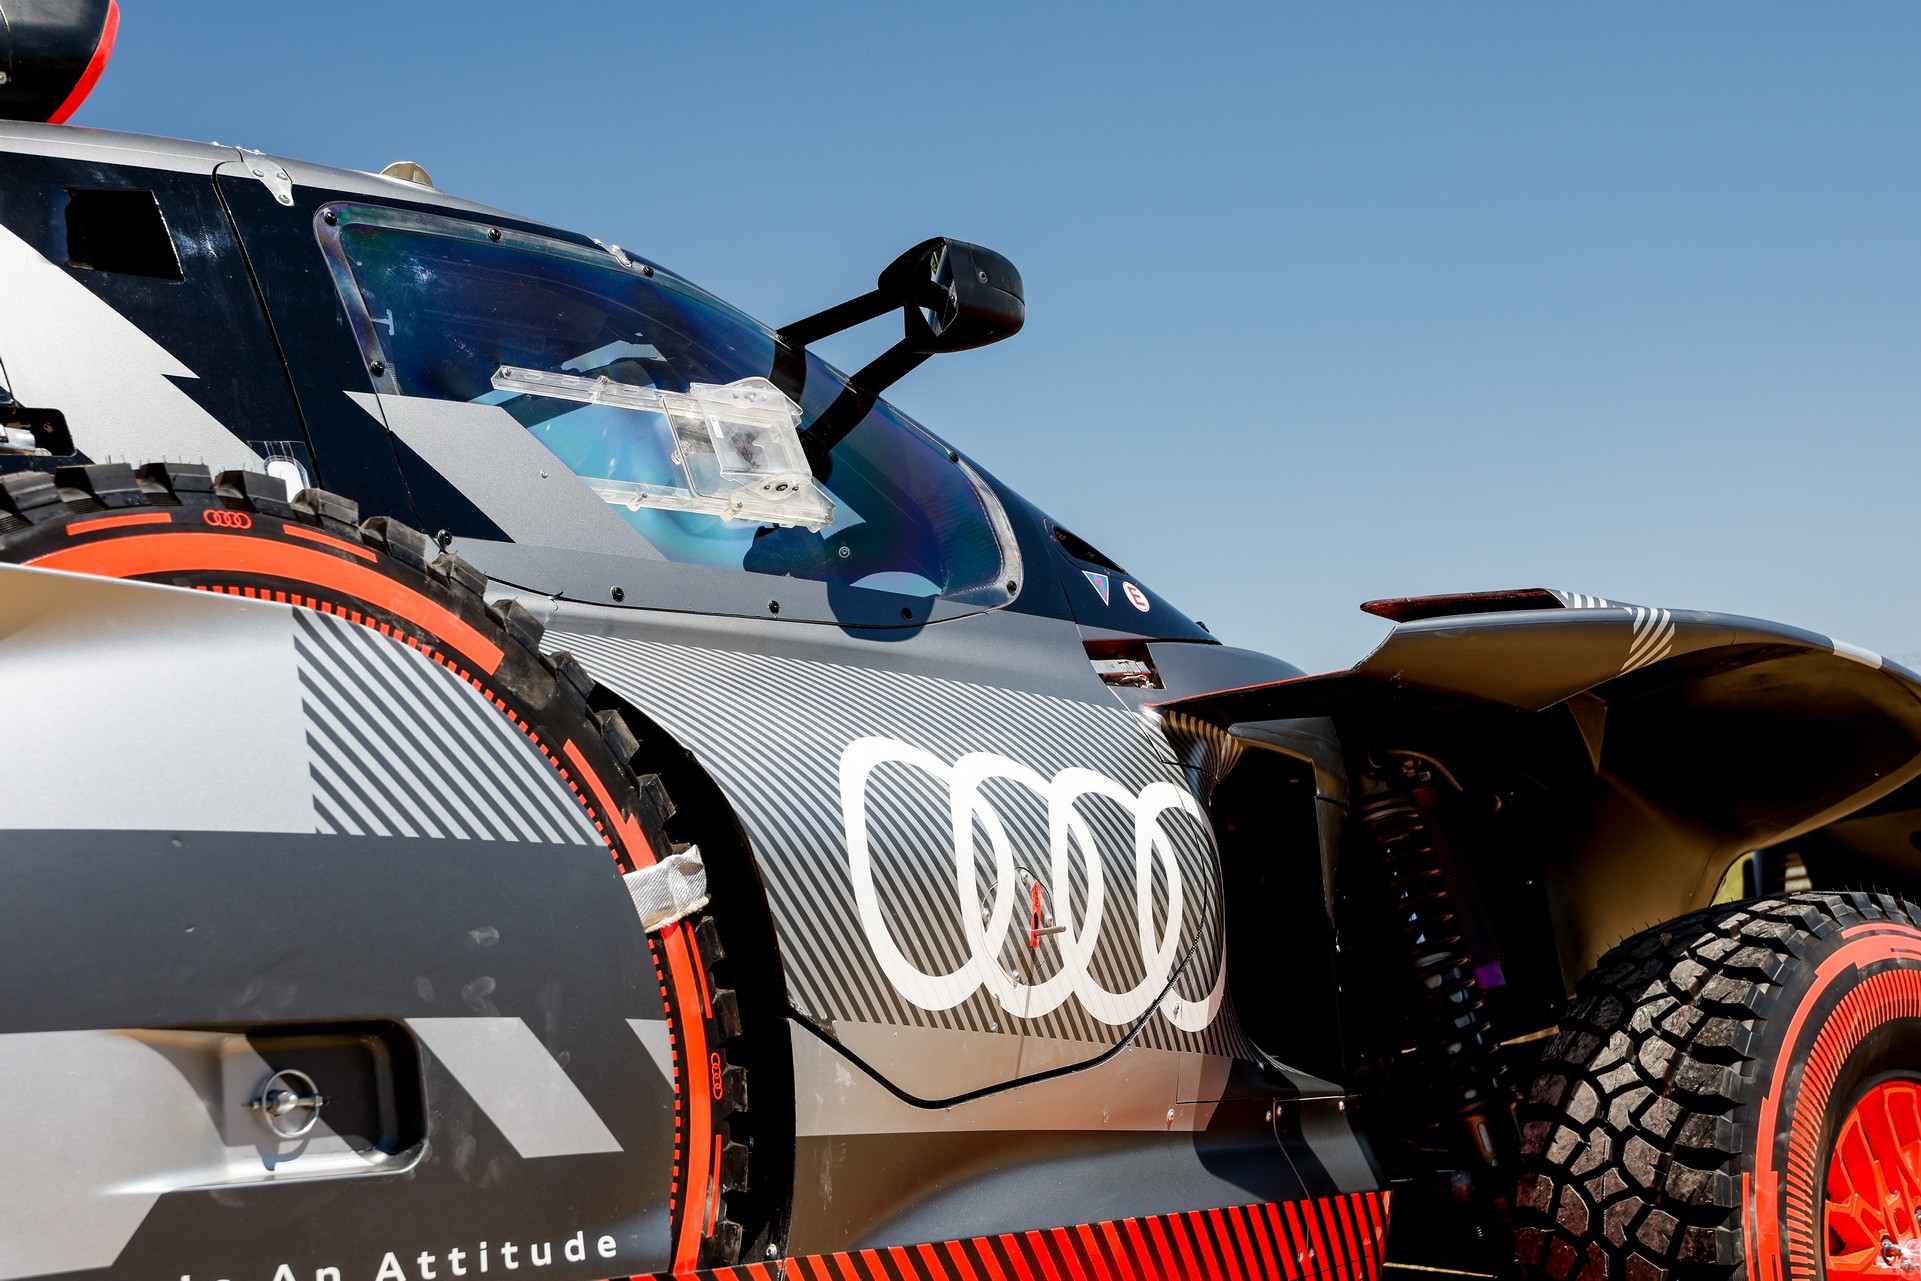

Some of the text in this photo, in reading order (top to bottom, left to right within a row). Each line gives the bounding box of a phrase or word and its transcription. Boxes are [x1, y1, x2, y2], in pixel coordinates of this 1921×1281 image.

[1127, 586, 1146, 606] E
[272, 1231, 617, 1281] An Attitude
